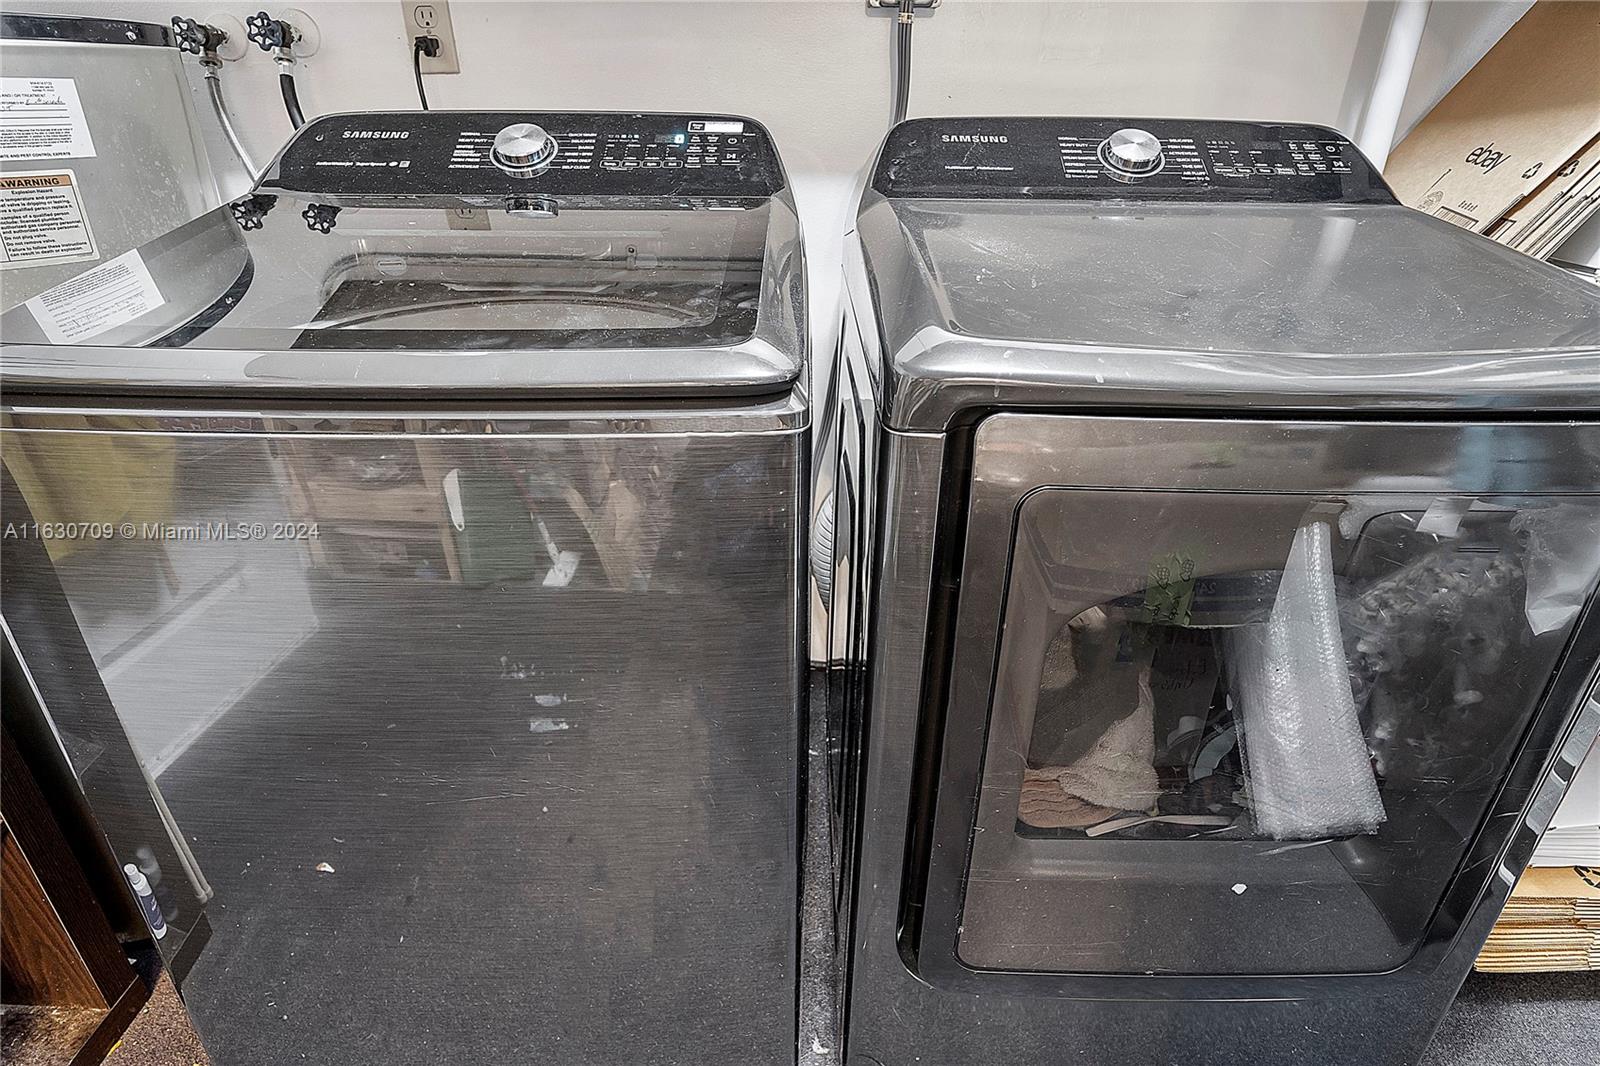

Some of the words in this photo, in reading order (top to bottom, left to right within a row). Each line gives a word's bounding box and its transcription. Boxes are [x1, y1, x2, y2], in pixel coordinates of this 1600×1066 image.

[342, 131, 410, 139] SAMSUNG
[942, 134, 1008, 144] SAMSUNG
[1465, 142, 1512, 175] ebay
[5, 177, 60, 188] WARNING
